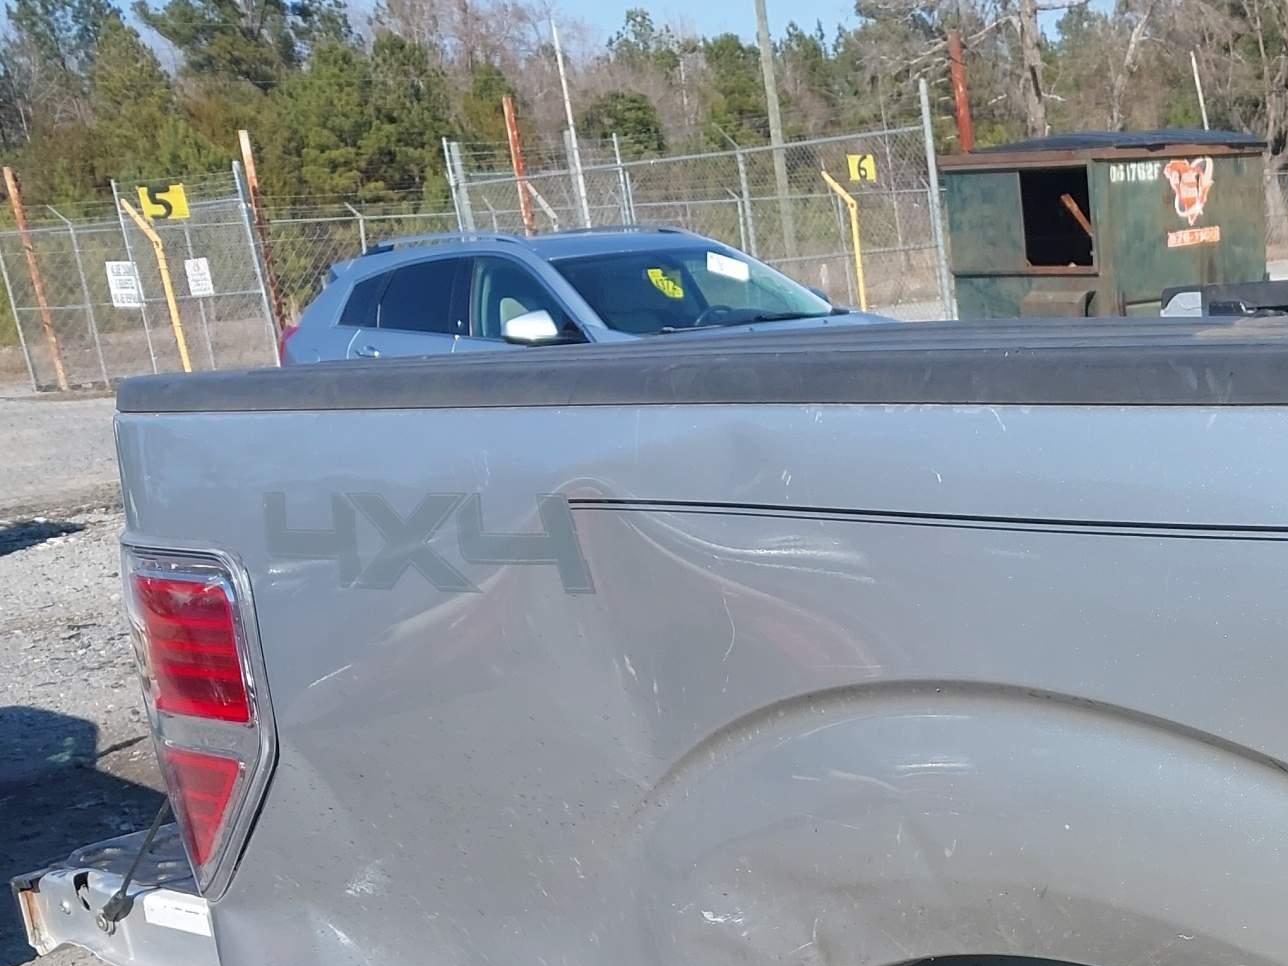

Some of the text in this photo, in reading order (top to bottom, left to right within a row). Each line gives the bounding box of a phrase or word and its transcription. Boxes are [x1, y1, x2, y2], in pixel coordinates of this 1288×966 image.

[858, 155, 867, 179] 6
[147, 184, 172, 219] 5
[263, 491, 597, 594] 4X4
